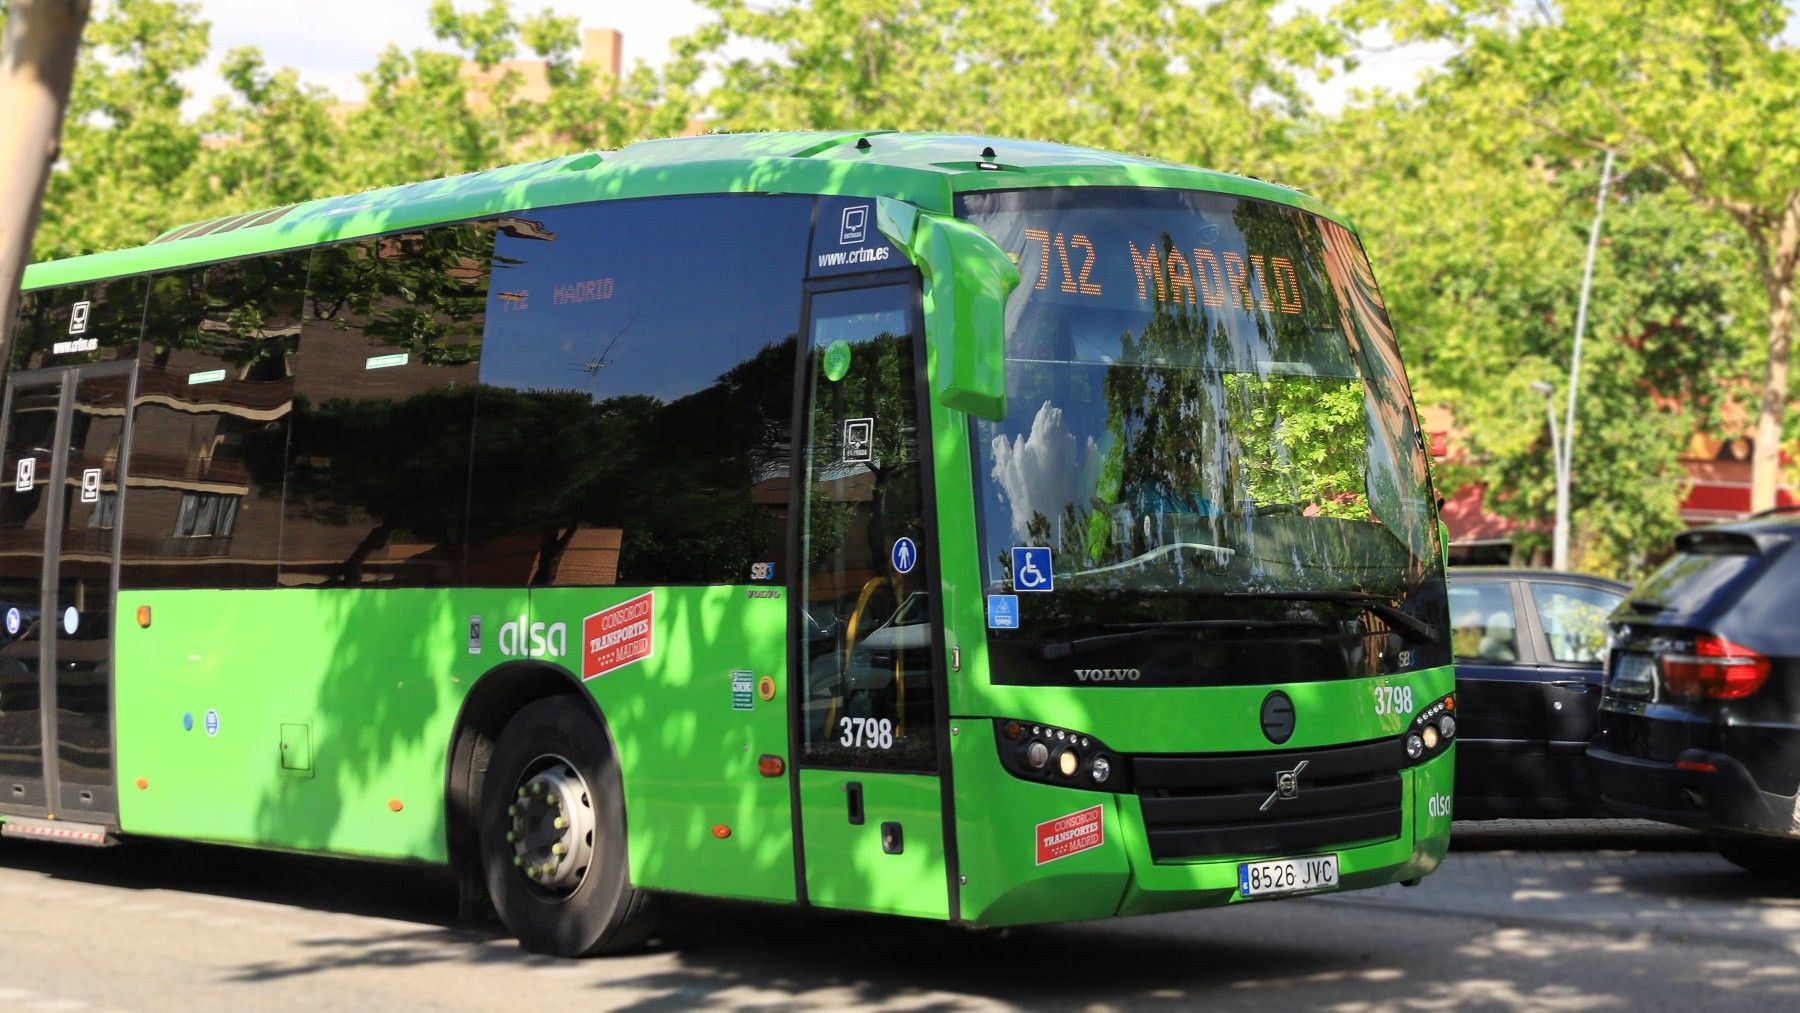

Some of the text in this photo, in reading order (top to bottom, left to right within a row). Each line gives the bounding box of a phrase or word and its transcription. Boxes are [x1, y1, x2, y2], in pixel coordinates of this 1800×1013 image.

[818, 247, 890, 267] www.crtm.es
[1024, 227, 1302, 314] 712 MADRID
[552, 278, 615, 305] MADRID
[747, 590, 781, 600] VOLVO
[601, 600, 649, 631] CONSORCIO
[498, 614, 567, 657] alsa
[590, 619, 649, 653] TRANSPORTES
[614, 638, 650, 663] MADRID
[1074, 668, 1141, 682] VOLVO
[1374, 686, 1413, 715] 3798
[840, 716, 893, 750] 3798
[1428, 791, 1451, 817] alsa
[1054, 809, 1099, 832] CONSORCIO
[1043, 821, 1099, 848] TRANSPORTES
[1069, 833, 1100, 851] MADRID
[1251, 860, 1333, 890] 8526 JVC
